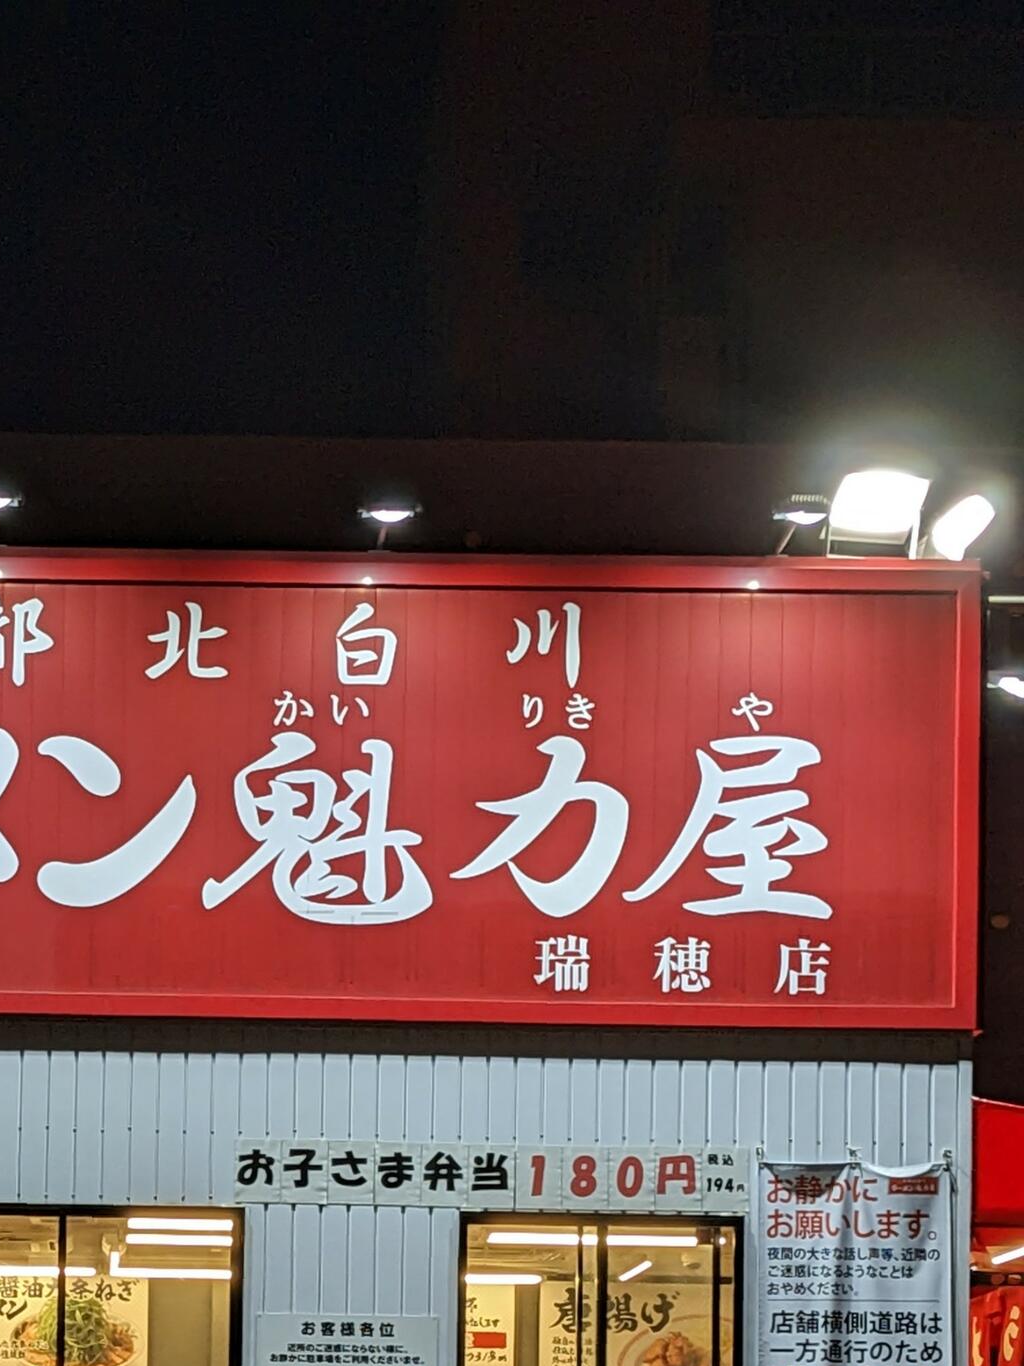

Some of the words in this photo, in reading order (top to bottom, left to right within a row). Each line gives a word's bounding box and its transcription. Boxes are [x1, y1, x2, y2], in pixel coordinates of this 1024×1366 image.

[273, 691, 369, 727] かい
[523, 693, 596, 729] りき
[731, 692, 774, 732] や
[534, 935, 833, 995] 瑞穂店
[237, 1148, 509, 1192] お子さま弁当
[530, 1153, 698, 1197] 180円
[766, 1174, 879, 1206] お静かに
[766, 1208, 938, 1241] お願いします。
[767, 1246, 941, 1263] 夜間の大きな話し声等、近隣の
[767, 1265, 914, 1280] ご迷惑になるようなことは
[767, 1281, 860, 1297] おやめください。
[301, 1321, 395, 1338] お客様各位
[769, 1310, 944, 1335] 店舗横側道路は
[769, 1339, 944, 1364] 一方通行のため
